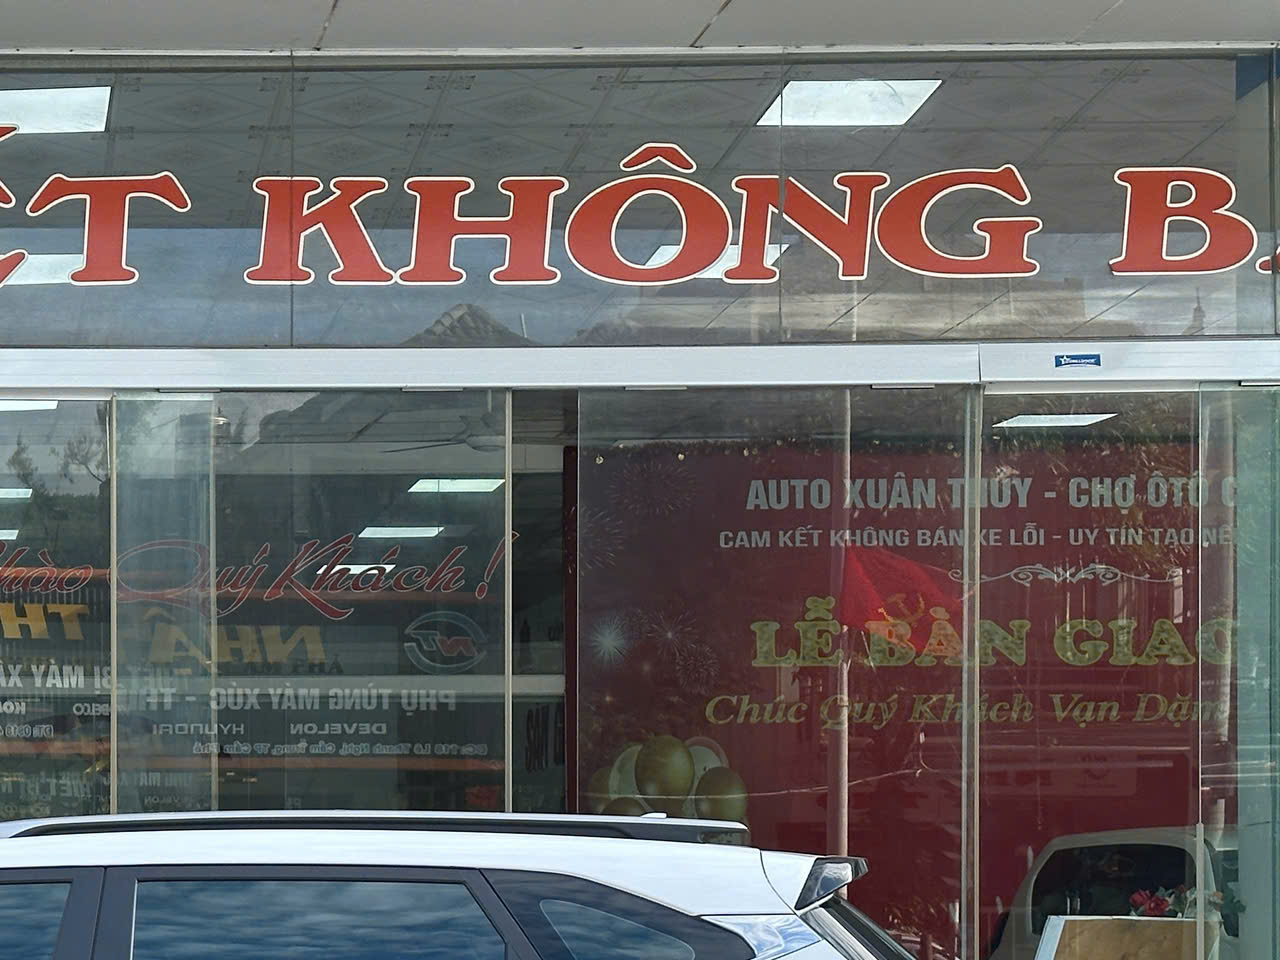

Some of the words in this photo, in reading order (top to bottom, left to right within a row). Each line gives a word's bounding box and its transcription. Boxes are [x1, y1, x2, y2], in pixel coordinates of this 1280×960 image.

[243, 142, 1044, 286] KHÔNG
[745, 478, 831, 511] AUTO
[842, 471, 937, 510] XUÂN
[1068, 473, 1137, 515] CHỢ
[719, 529, 771, 549] CAM
[777, 524, 824, 548] KẾT
[829, 526, 910, 548] KHÔNG
[916, 526, 965, 547] BÁN
[1009, 522, 1046, 546] LỖI
[1068, 528, 1100, 546] UY
[1105, 525, 1144, 546] TÍN
[749, 595, 844, 668] LỄ
[704, 694, 809, 725] Chúc
[819, 693, 899, 730] Quý
[907, 692, 1035, 724] Khách
[1047, 692, 1121, 729] Vạn
